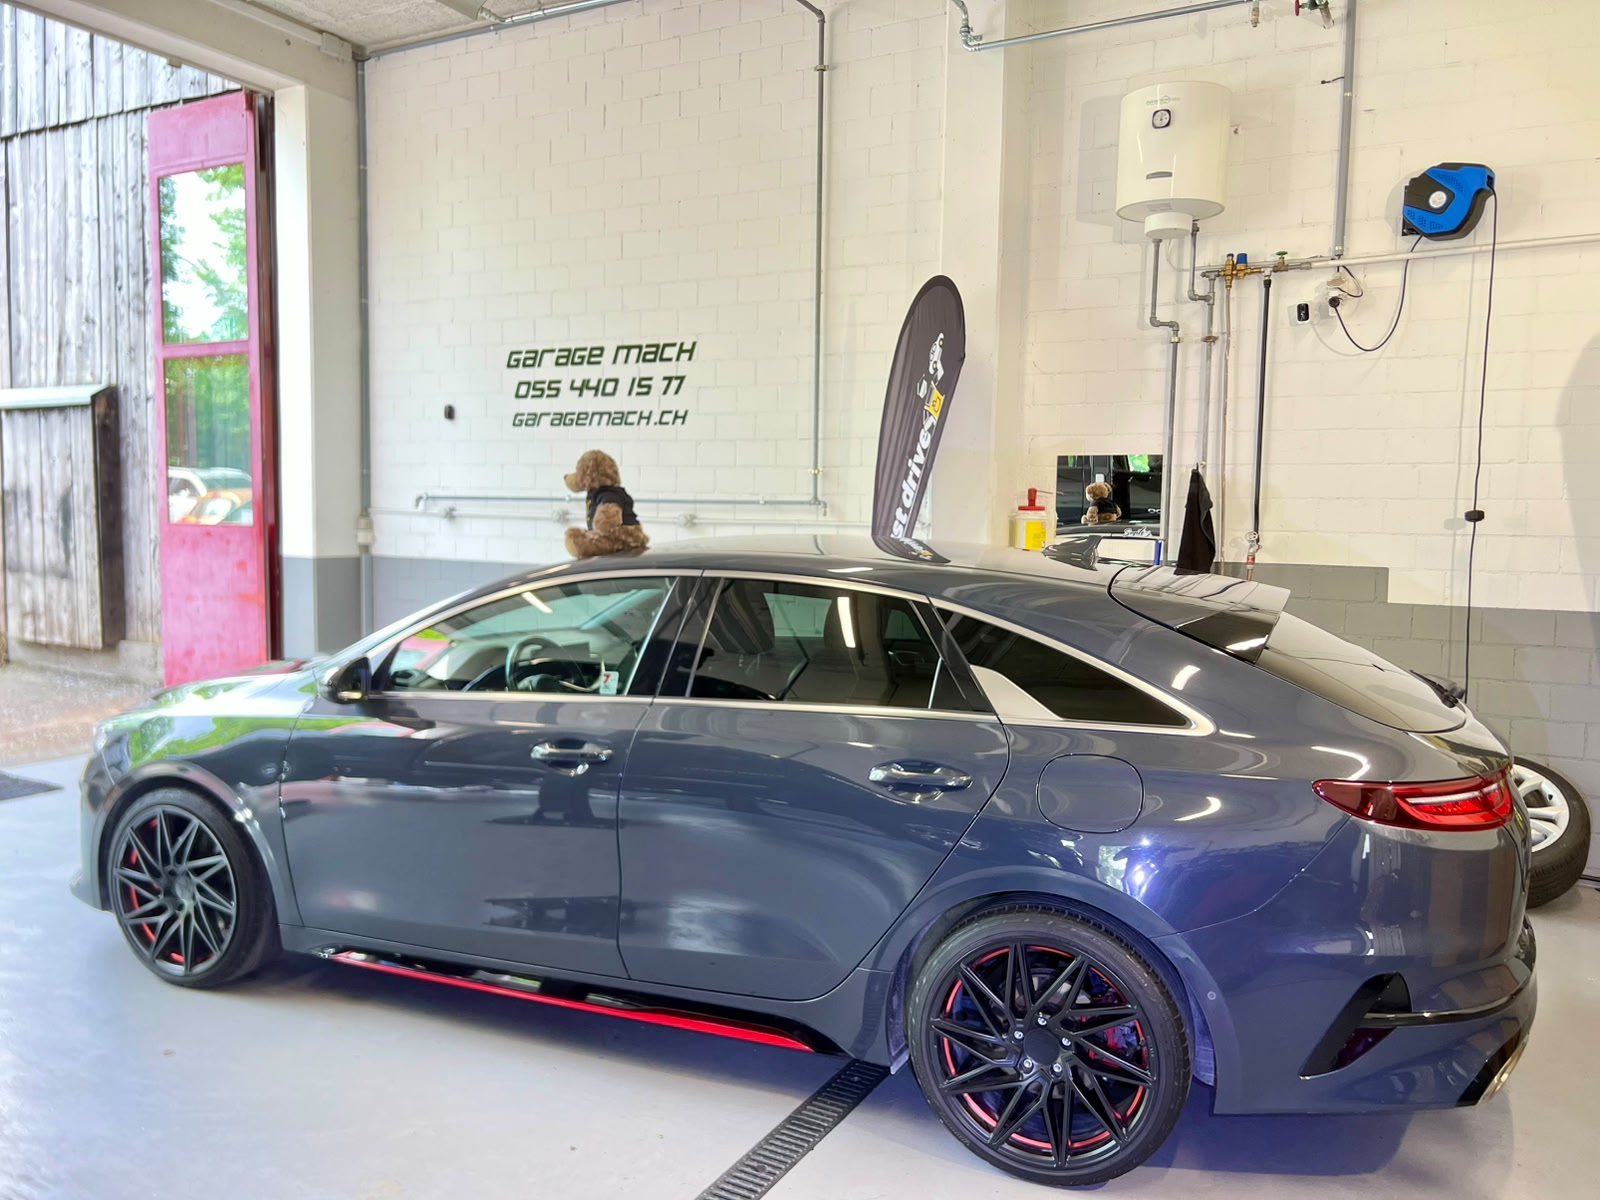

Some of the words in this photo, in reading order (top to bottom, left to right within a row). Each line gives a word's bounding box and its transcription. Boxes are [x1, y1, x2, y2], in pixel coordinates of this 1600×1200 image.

[514, 379, 562, 399] 055
[569, 377, 620, 398] 440
[627, 376, 653, 396] 15
[662, 375, 687, 396] 77
